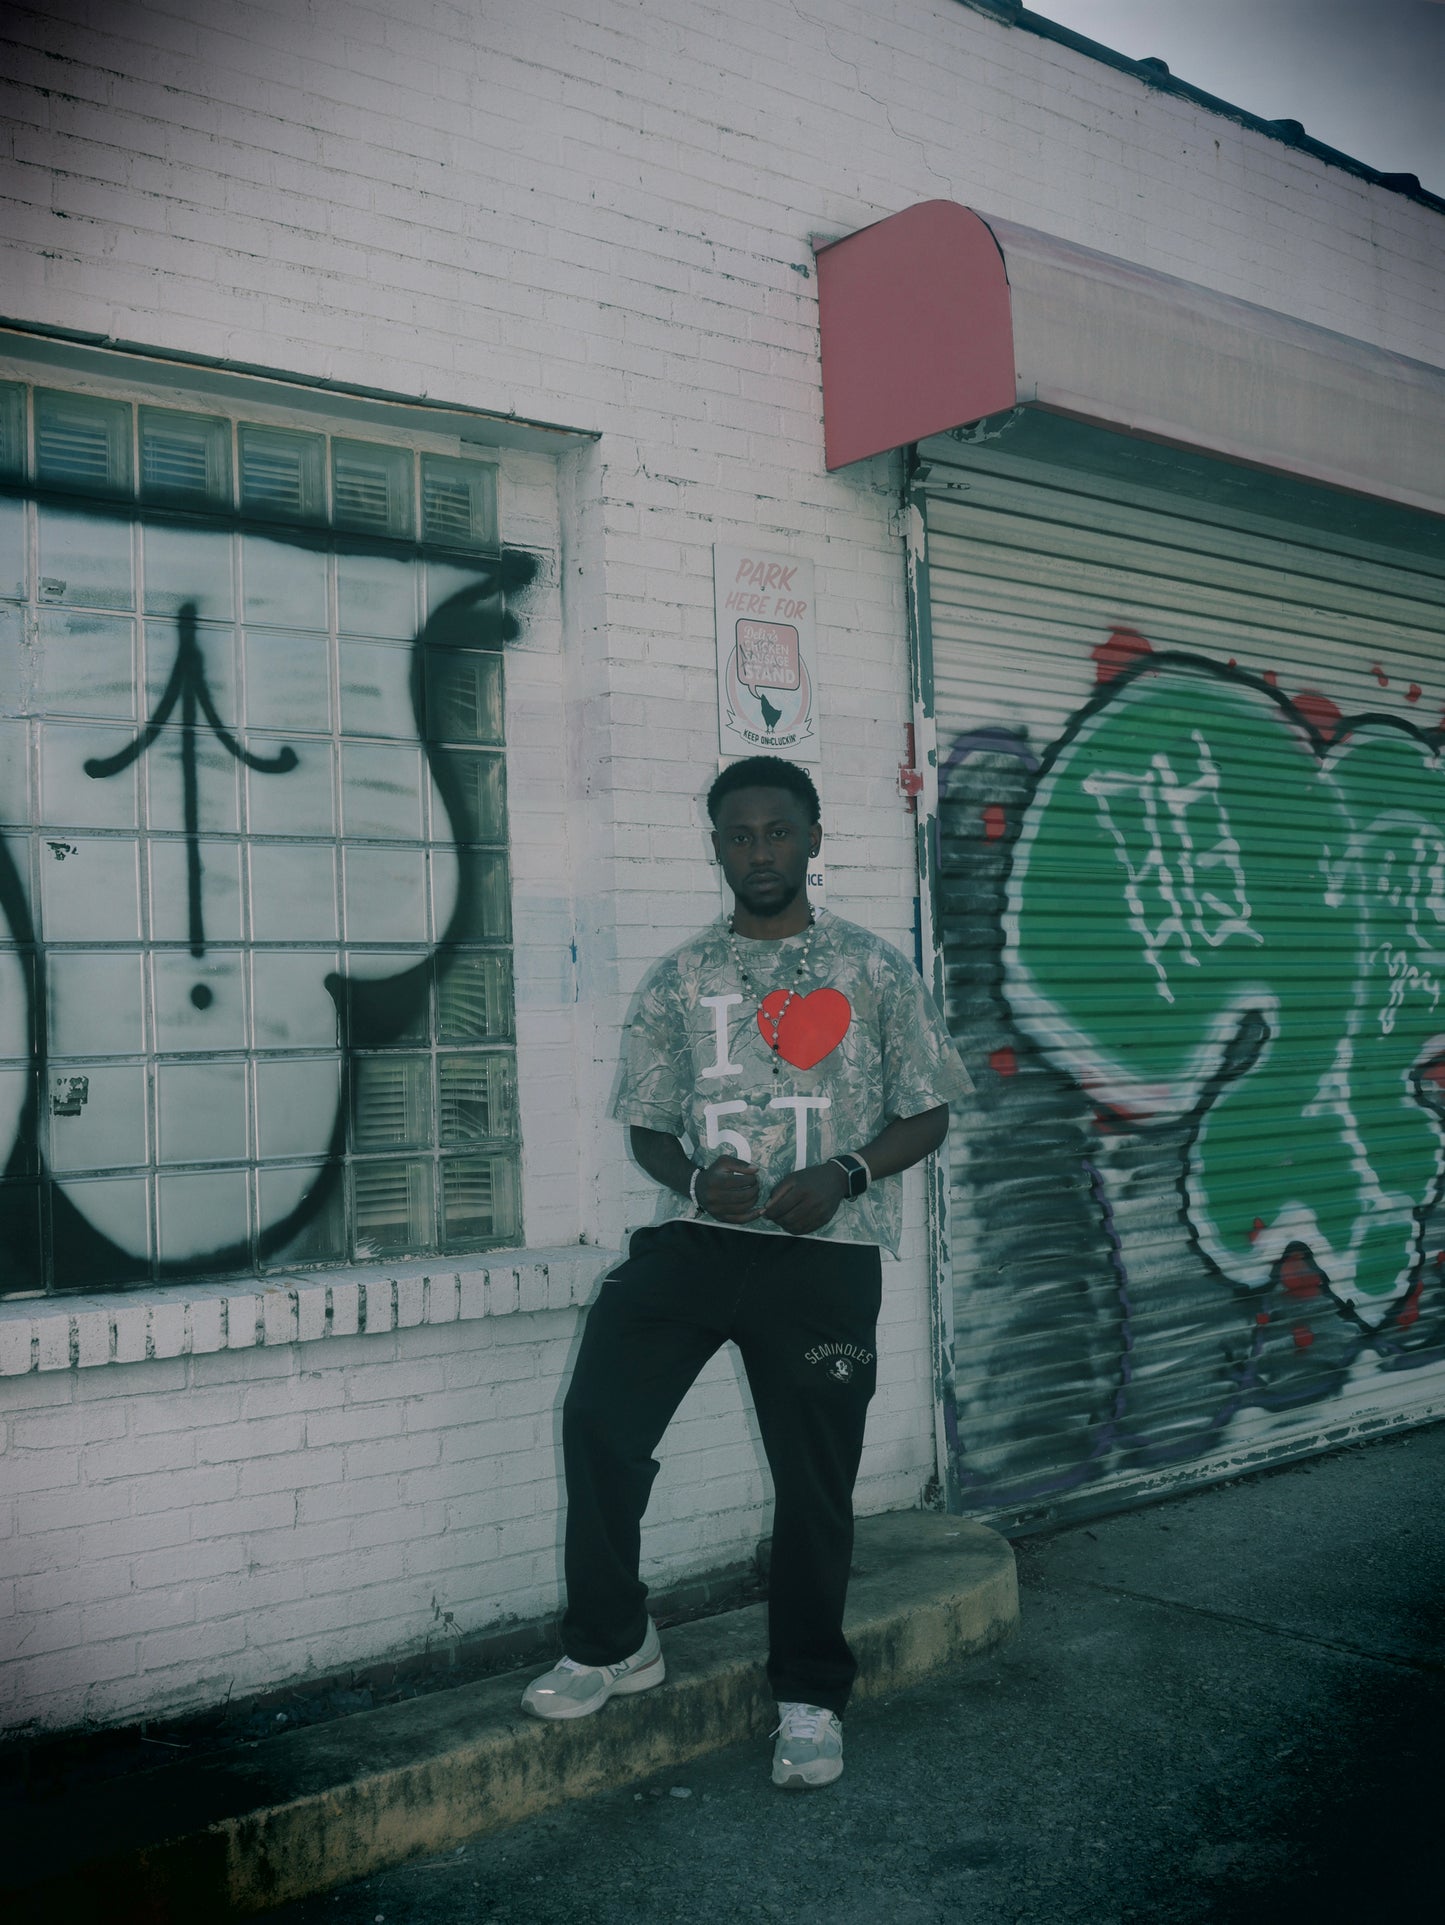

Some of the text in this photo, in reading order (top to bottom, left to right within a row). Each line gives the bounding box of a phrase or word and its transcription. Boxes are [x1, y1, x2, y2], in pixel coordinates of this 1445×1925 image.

[735, 558, 798, 592] PARK
[725, 591, 807, 620] HERE FOR
[743, 640, 789, 655] CHICKEN
[744, 650, 790, 667] SAUSAGE
[745, 664, 796, 684] STAND
[743, 729, 759, 742] KEEP
[807, 873, 823, 886] ICE
[700, 994, 743, 1077] I
[804, 1342, 874, 1364] SEMINOLES
